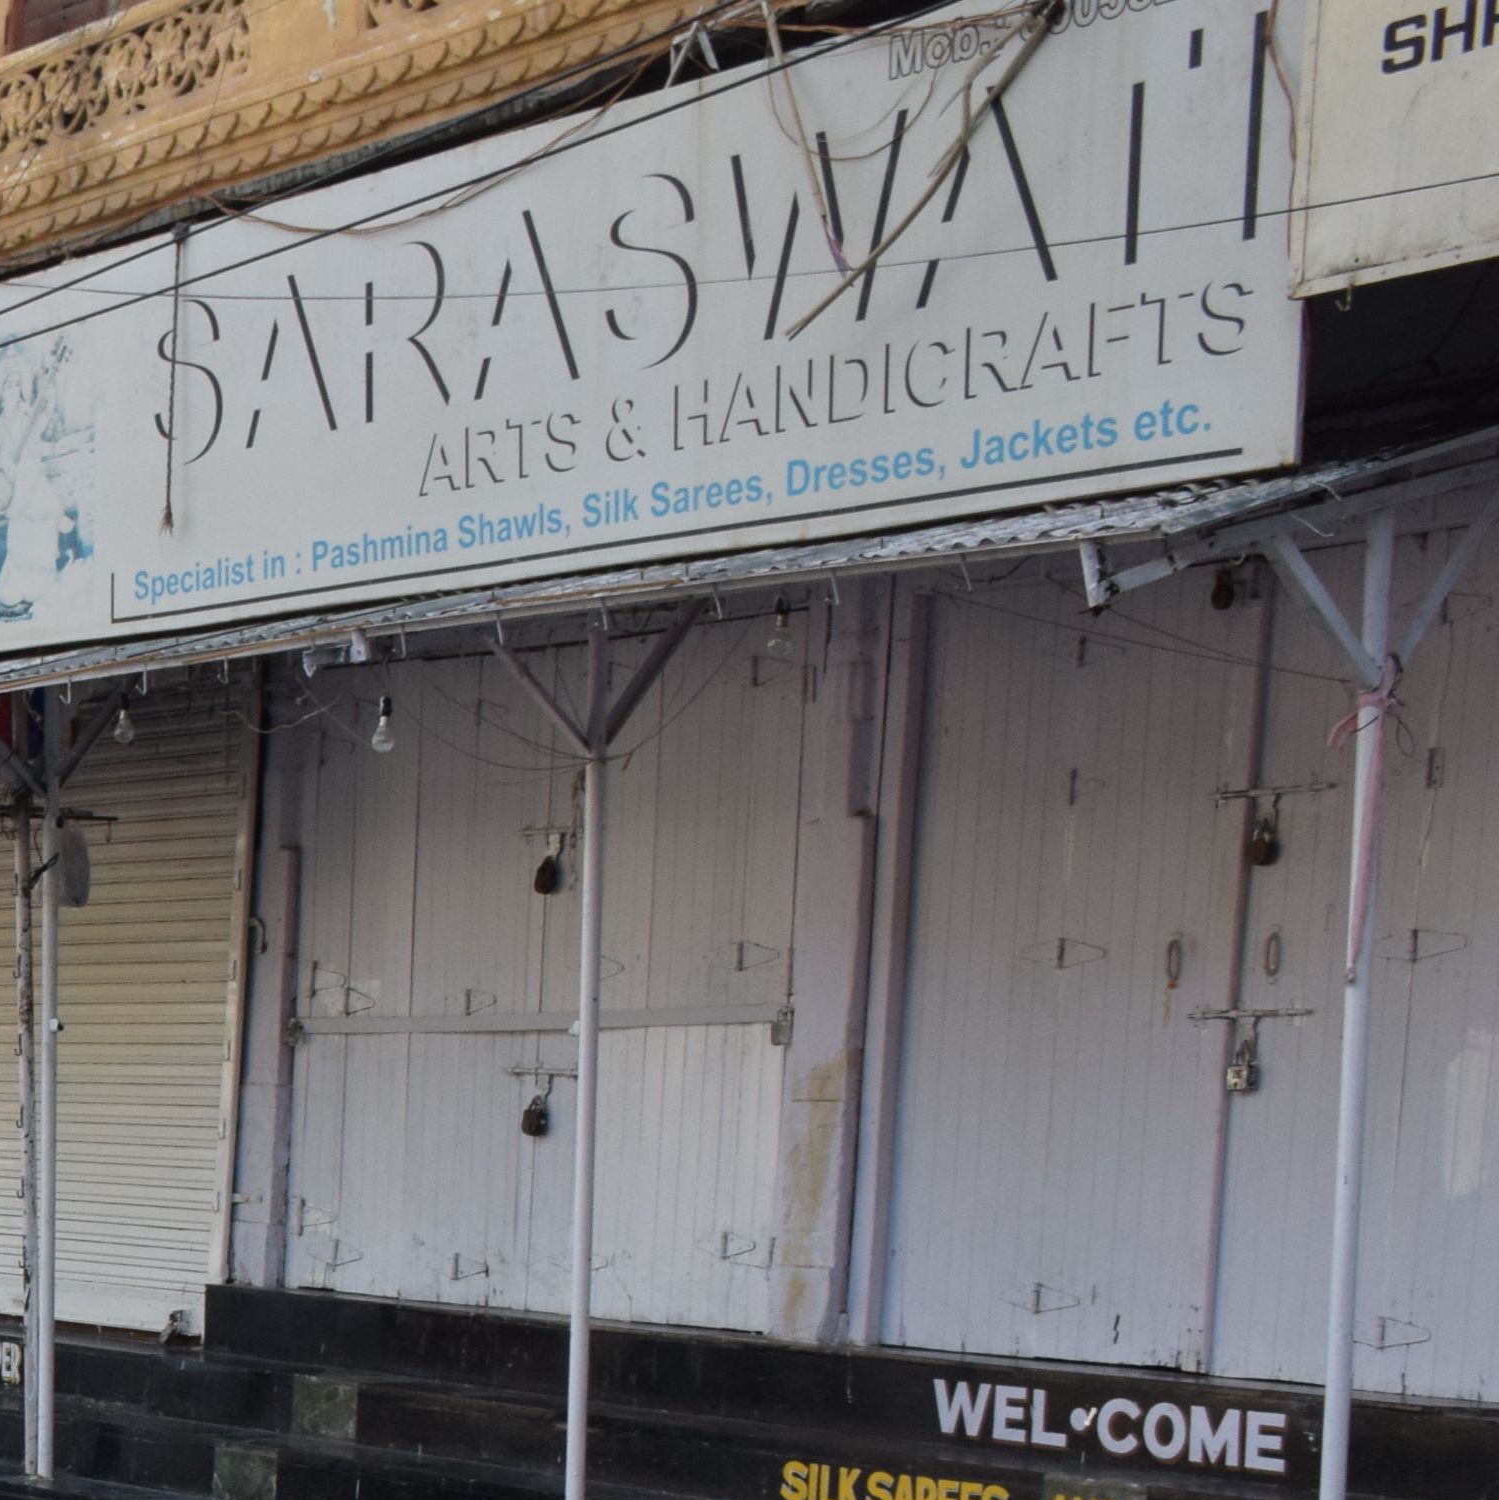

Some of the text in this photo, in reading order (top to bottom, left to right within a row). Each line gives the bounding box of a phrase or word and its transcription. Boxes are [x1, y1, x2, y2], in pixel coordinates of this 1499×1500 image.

[418, 281, 1254, 497] ARTS & HANDICRAFTS
[134, 555, 253, 605] Specialist
[263, 550, 285, 580] in
[312, 525, 448, 572] Pashmina
[458, 503, 572, 551] Shawls,
[583, 487, 639, 529] Silk
[651, 472, 772, 521] Sarees,
[786, 448, 947, 497] Dresses,
[960, 412, 1118, 470] Jackets
[1134, 400, 1212, 442] etc.
